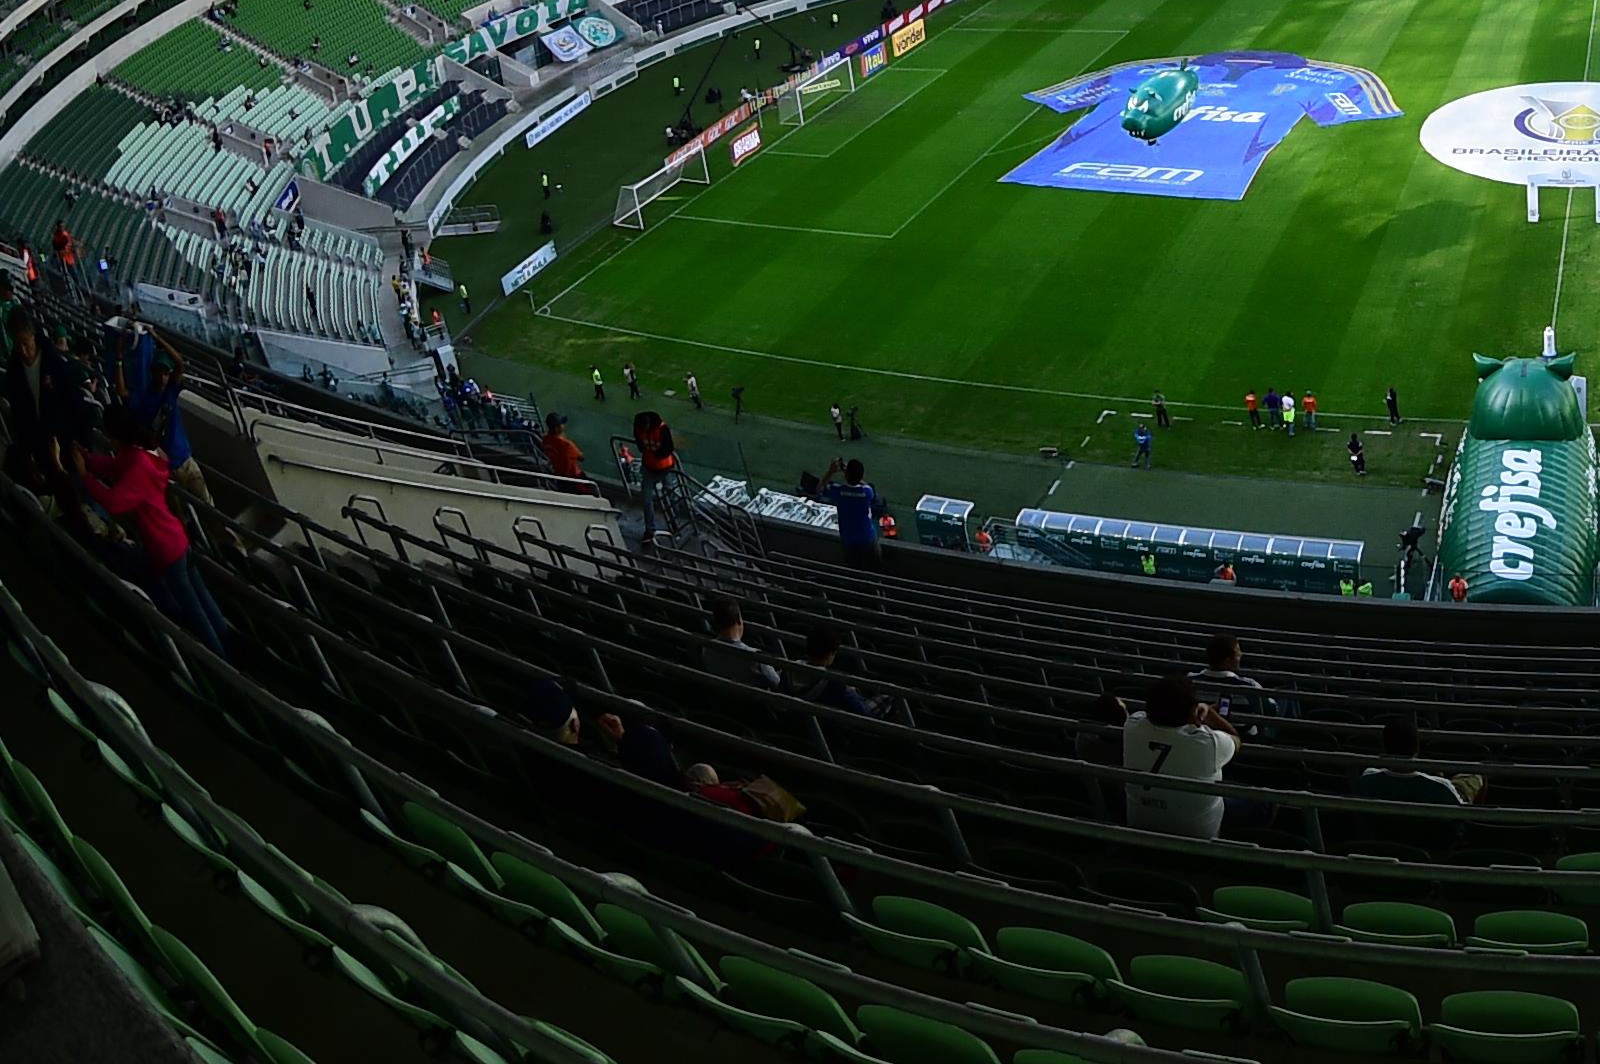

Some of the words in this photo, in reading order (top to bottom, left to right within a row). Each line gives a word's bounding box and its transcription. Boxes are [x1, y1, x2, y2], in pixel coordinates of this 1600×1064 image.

[895, 27, 924, 53] vonder
[865, 48, 884, 73] Itaú
[1477, 448, 1557, 581] crefisa
[1143, 740, 1173, 792] 7
